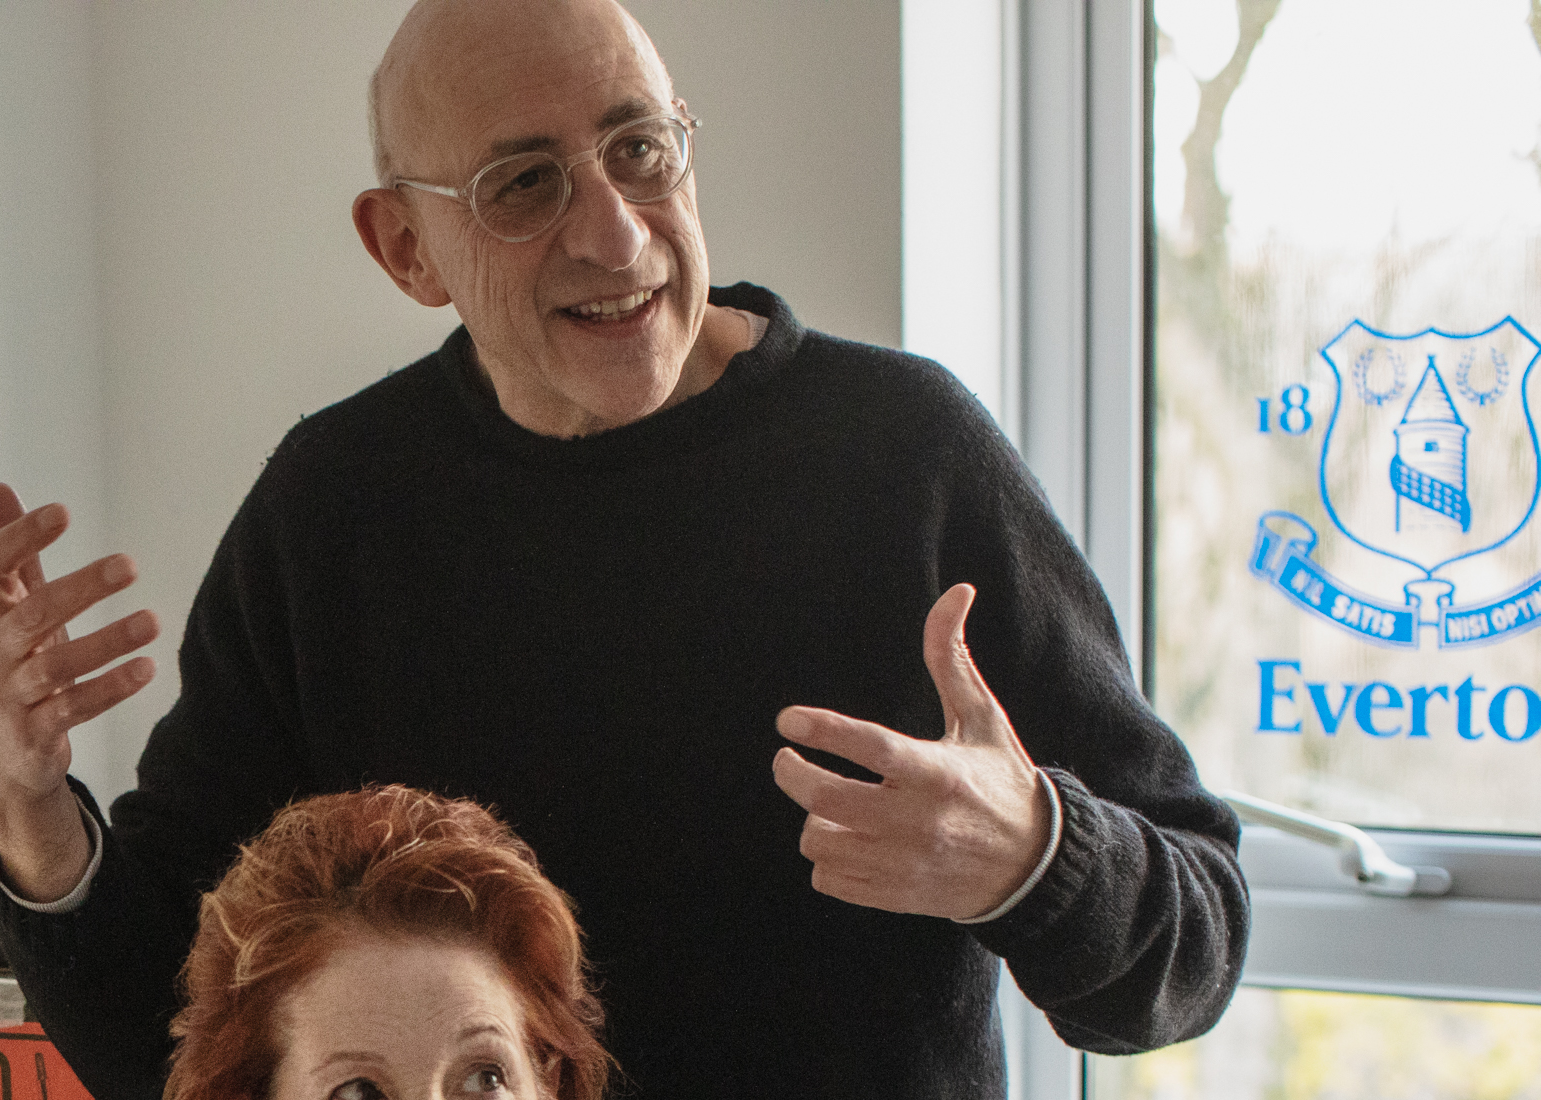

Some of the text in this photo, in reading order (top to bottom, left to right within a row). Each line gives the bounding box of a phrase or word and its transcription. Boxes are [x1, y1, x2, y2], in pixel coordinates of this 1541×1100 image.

[1255, 384, 1314, 436] 18
[1331, 594, 1396, 638] SATIS
[1446, 612, 1490, 642] NISI
